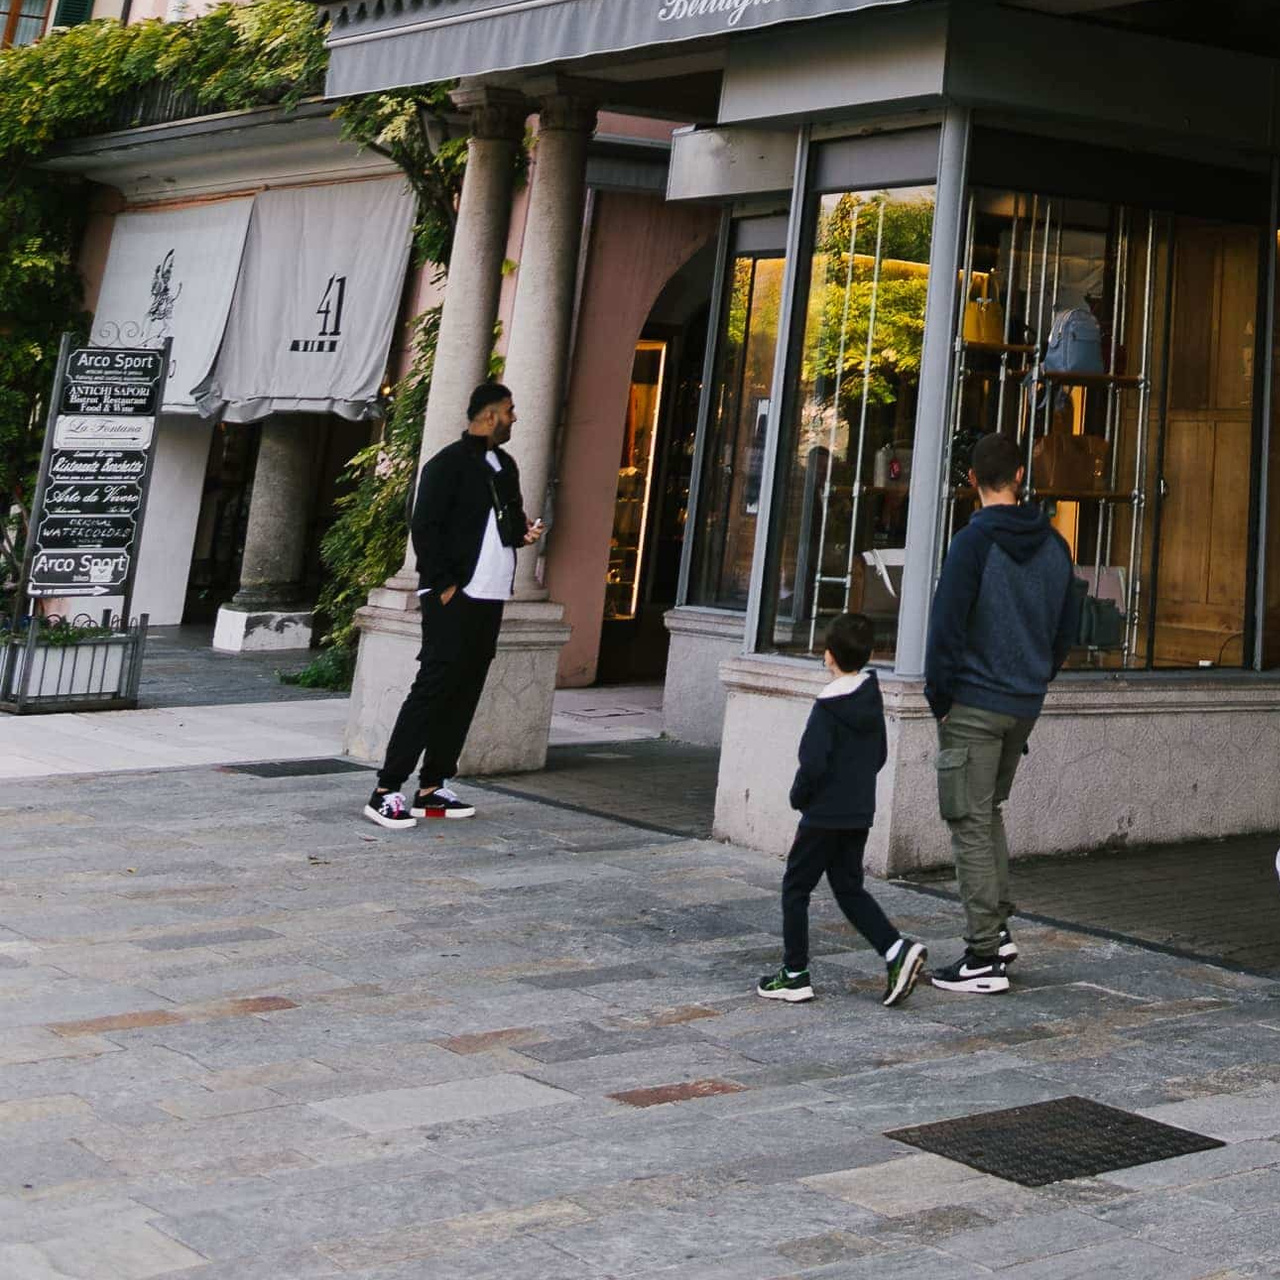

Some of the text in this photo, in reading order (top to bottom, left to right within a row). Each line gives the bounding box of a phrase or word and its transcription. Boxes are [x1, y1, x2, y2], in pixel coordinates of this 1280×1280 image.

[315, 272, 347, 337] 41
[77, 352, 110, 367] Arco
[114, 353, 153, 370] Sport
[68, 385, 150, 397] ANTICHI SAPORI
[80, 403, 102, 412] Food
[34, 555, 75, 573] Arco
